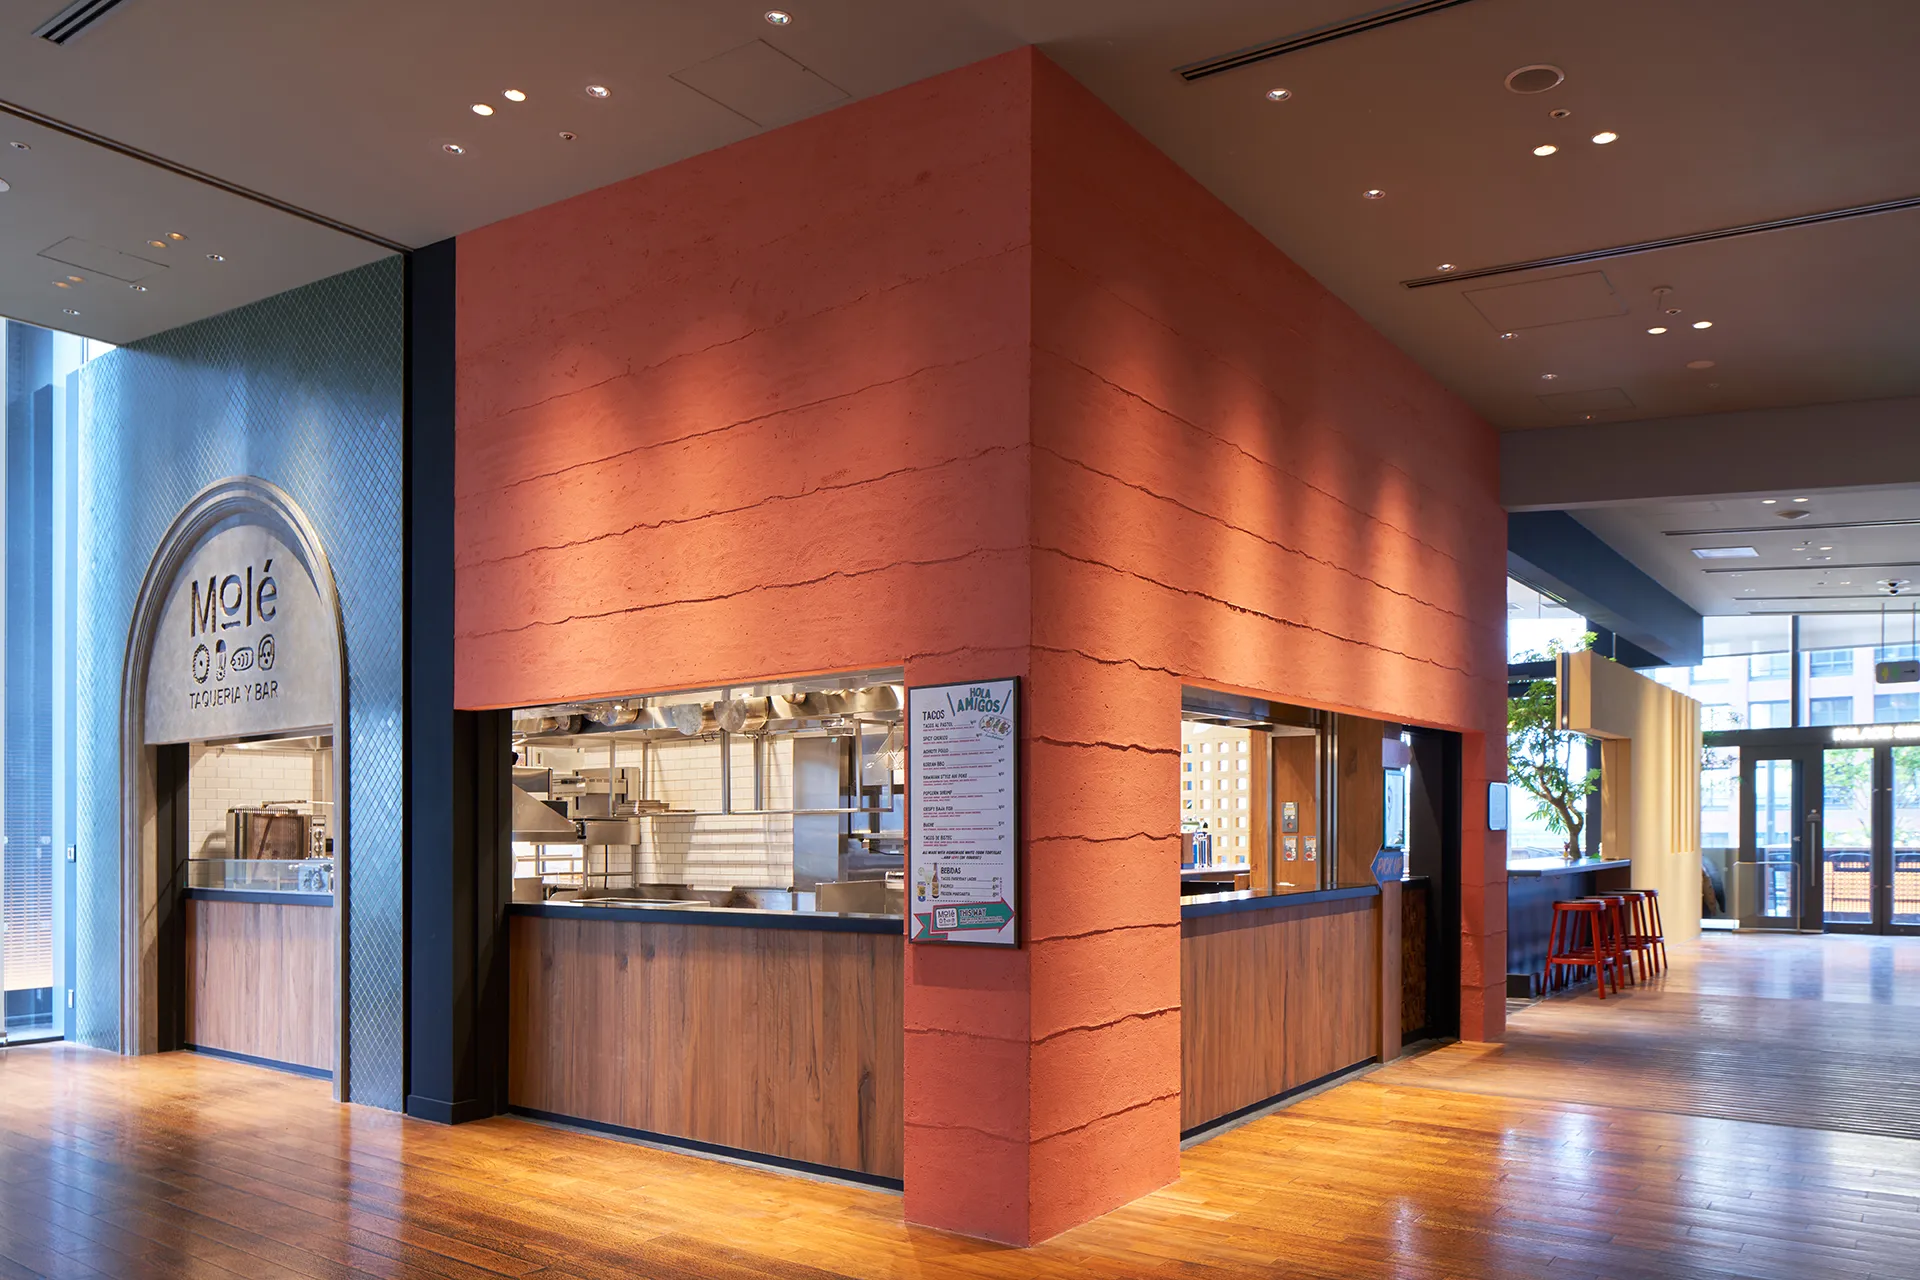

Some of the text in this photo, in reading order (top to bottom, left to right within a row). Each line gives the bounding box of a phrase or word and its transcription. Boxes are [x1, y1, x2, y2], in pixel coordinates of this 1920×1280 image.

[191, 559, 277, 637] Molé
[190, 680, 278, 709] TAQUERIA Y BAR
[969, 687, 991, 699] HOLA
[957, 697, 1000, 713] AMIGOS
[922, 710, 945, 720] TACOS
[941, 867, 961, 875] BEBIDAS
[1376, 857, 1394, 875] PICK
[973, 908, 986, 916] WAY
